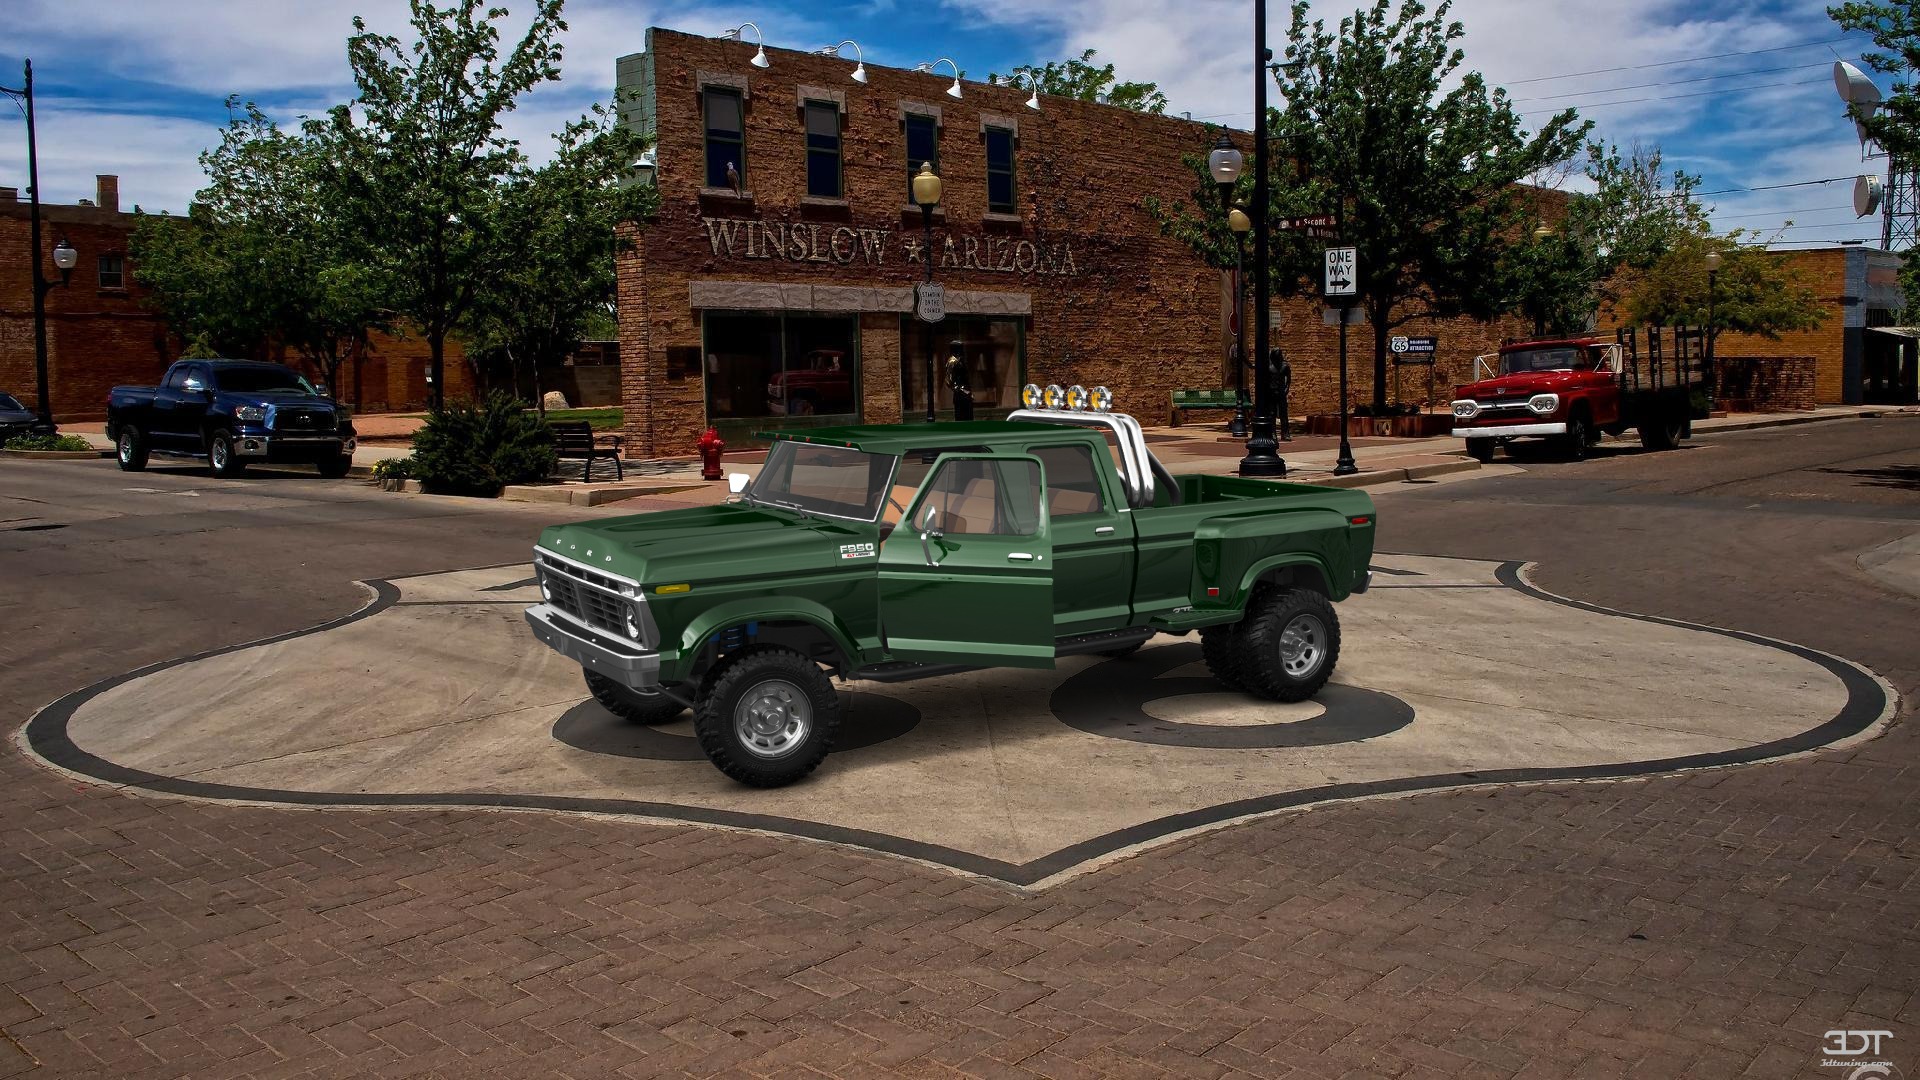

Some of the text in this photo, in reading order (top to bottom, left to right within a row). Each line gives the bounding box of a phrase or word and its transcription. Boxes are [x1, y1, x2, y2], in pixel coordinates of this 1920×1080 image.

[701, 217, 1078, 276] WINSLOW ARIZONA
[1329, 251, 1352, 263] ONE
[1329, 265, 1352, 275] WAY
[1395, 342, 1406, 351] 66
[556, 538, 612, 562] FORD
